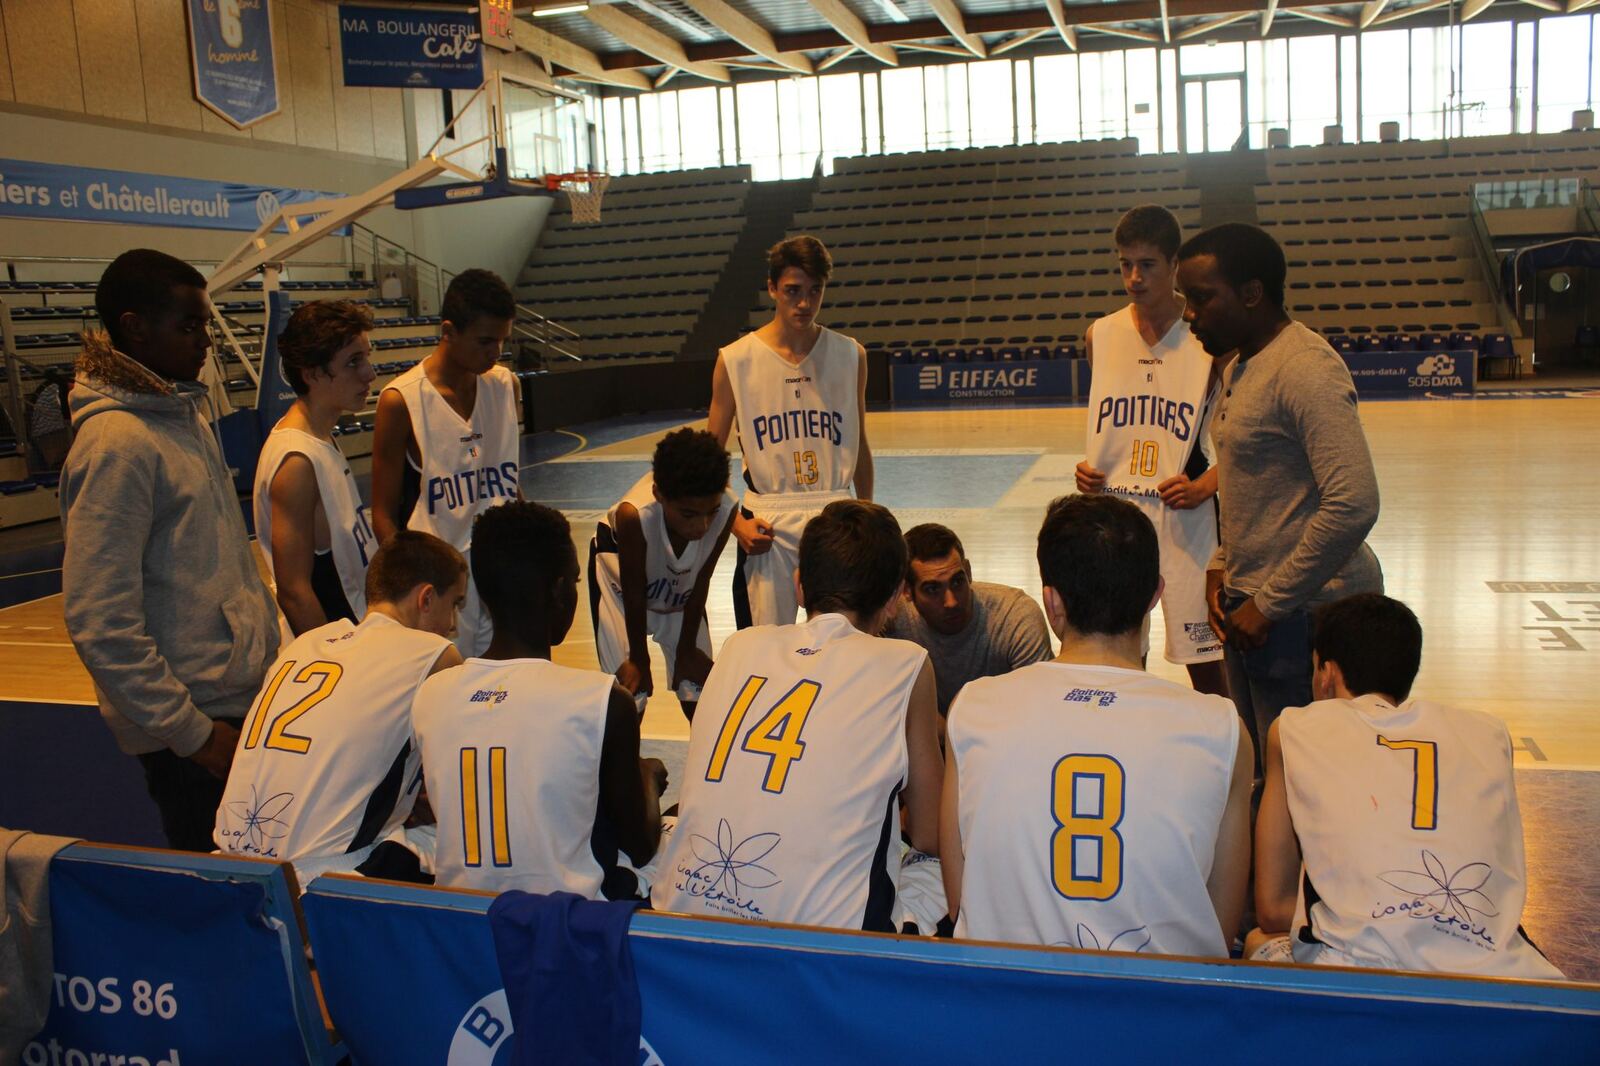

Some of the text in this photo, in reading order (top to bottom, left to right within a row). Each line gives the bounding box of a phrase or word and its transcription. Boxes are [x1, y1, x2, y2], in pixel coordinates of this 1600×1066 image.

[343, 19, 369, 33] MA
[423, 35, 477, 60] Café
[60, 185, 79, 208] et
[86, 182, 231, 219] Châtellerault
[949, 368, 1038, 389] EIFFAGE
[949, 389, 1015, 398] CONSTRUCTION
[753, 409, 843, 451] POITIERS
[793, 450, 819, 485] 13
[1130, 439, 1159, 477] 10
[245, 660, 344, 755] 12
[705, 674, 822, 794] 14
[1376, 735, 1437, 830] 7
[460, 746, 513, 867] 11
[1049, 753, 1126, 902] 8
[132, 980, 178, 1020] 86
